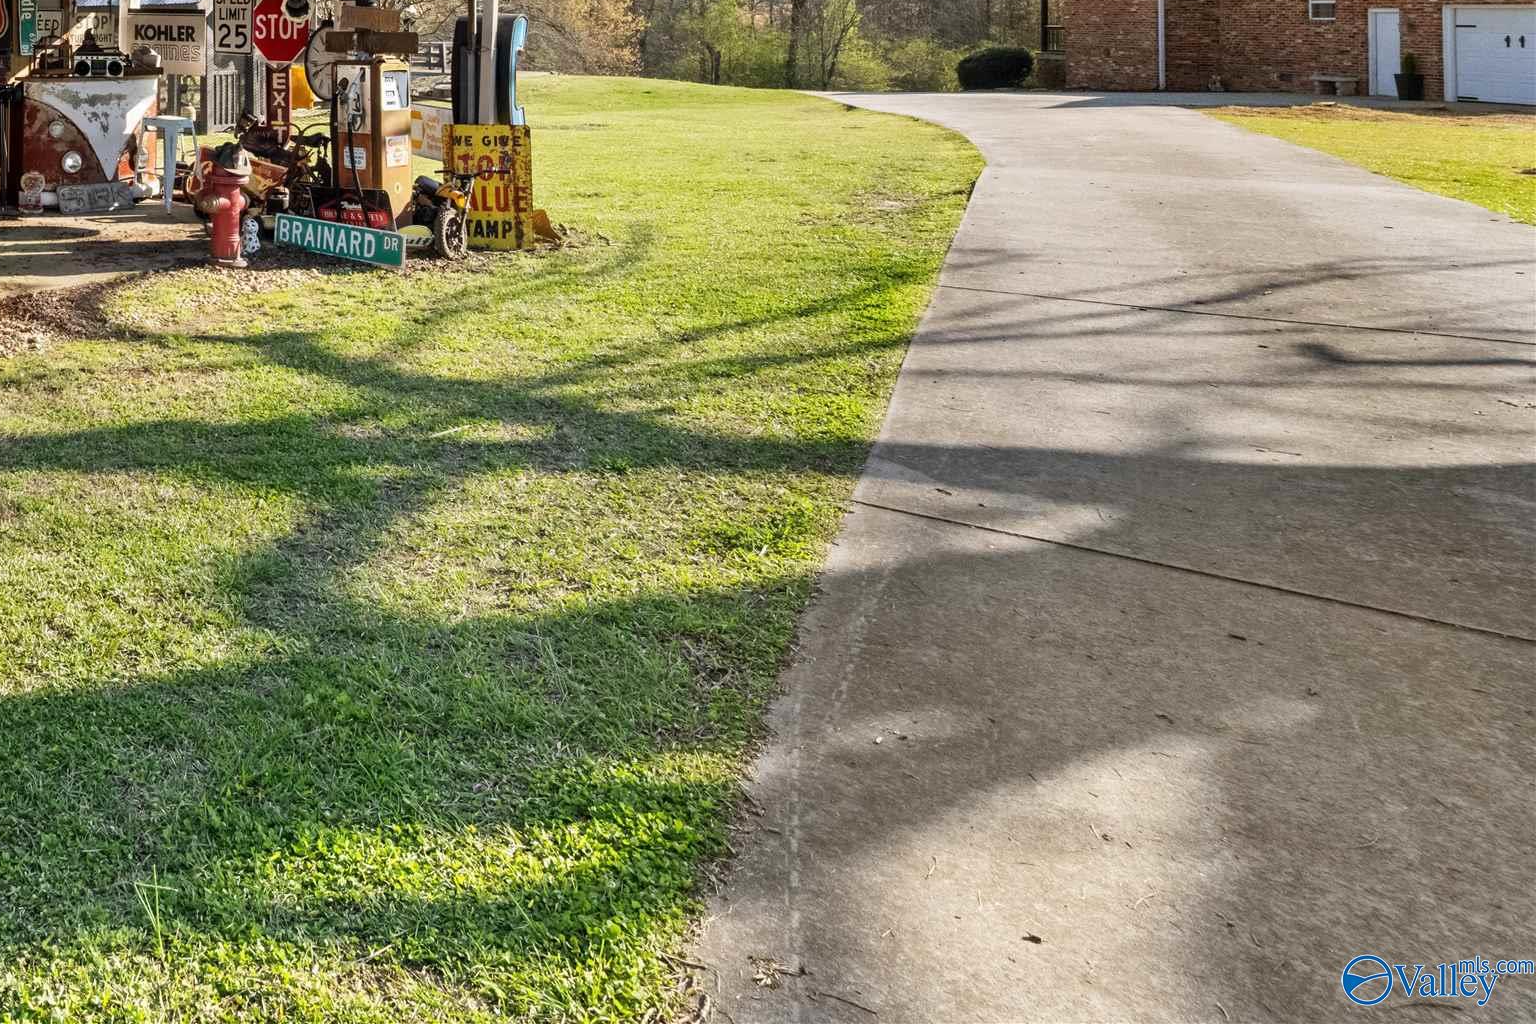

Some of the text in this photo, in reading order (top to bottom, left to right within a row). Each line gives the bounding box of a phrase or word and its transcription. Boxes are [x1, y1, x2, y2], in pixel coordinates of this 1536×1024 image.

[219, 7, 247, 21] LIMIT
[134, 24, 196, 43] KOHLER
[218, 23, 248, 49] 25
[255, 15, 309, 40] STOP
[272, 71, 288, 145] EXIT
[453, 134, 522, 147] WE GIVE
[467, 185, 530, 213] ALUE
[278, 219, 400, 258] BRAINARD DR
